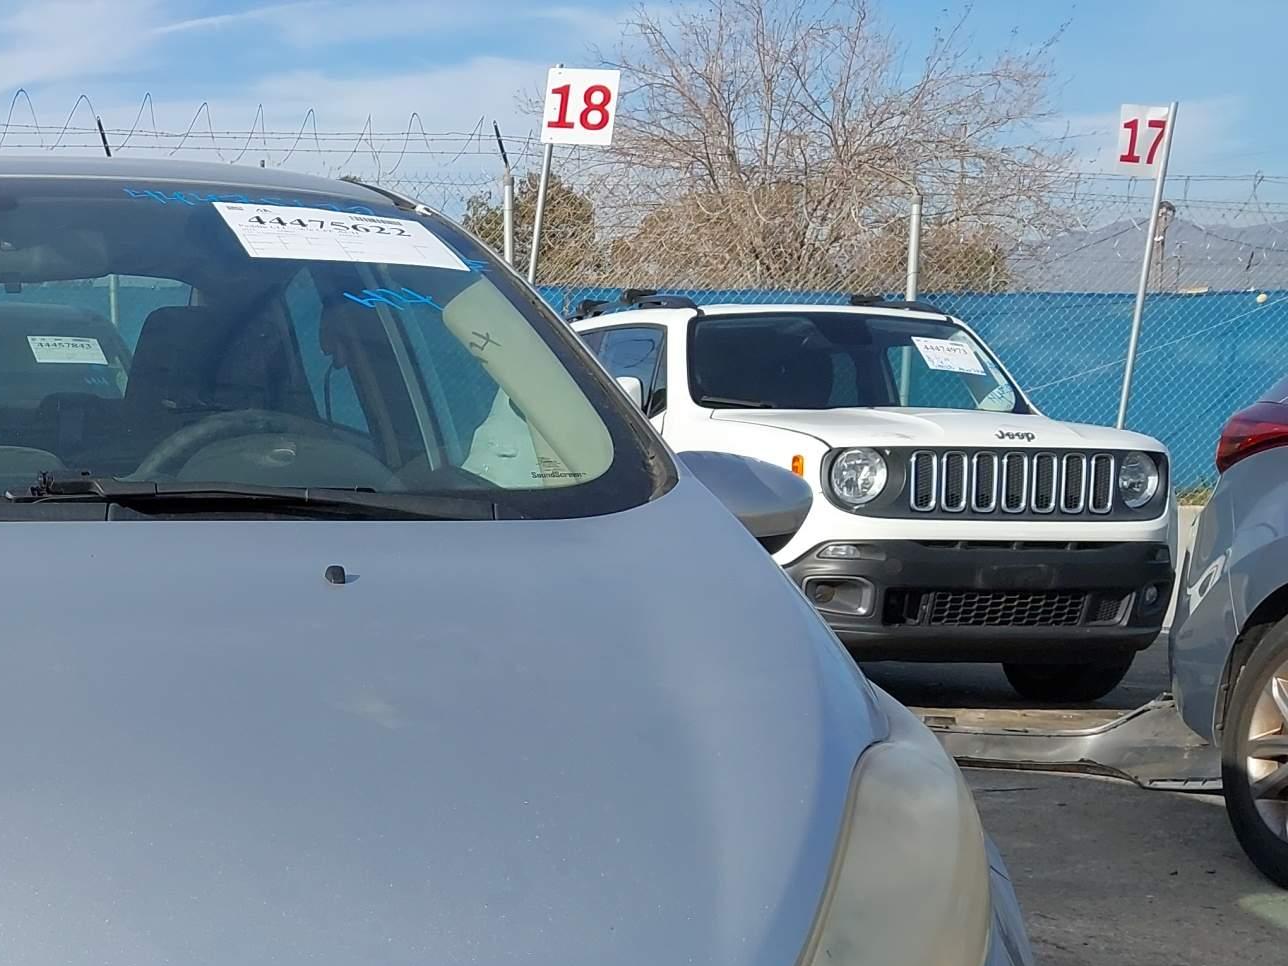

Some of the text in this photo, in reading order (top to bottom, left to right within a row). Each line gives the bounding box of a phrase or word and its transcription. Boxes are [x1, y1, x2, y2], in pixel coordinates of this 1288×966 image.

[546, 83, 613, 132] 18
[1120, 119, 1167, 165] 17
[248, 214, 412, 238] 44475622
[995, 430, 1036, 442] Jeep
